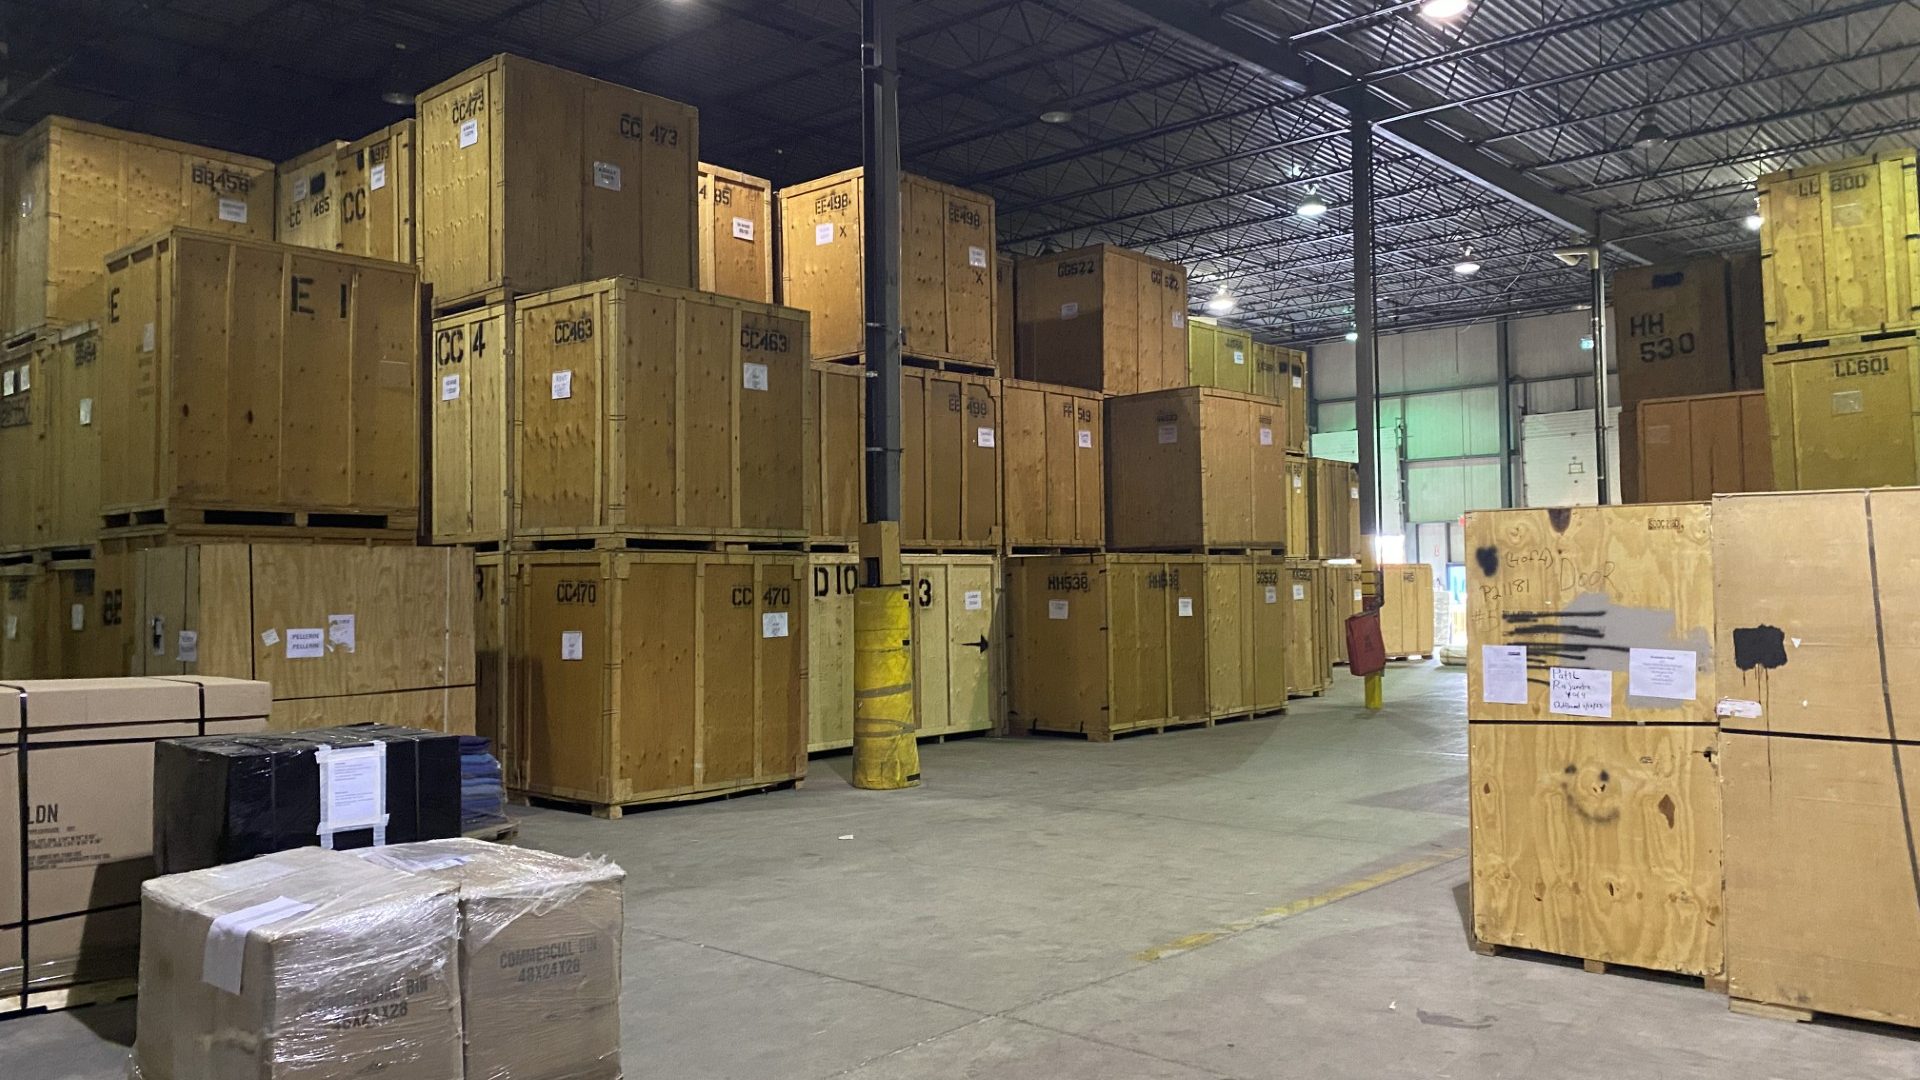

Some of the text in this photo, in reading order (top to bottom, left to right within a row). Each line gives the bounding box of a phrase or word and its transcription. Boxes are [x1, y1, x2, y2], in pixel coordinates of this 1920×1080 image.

[620, 117, 678, 147] CC 473
[1799, 182, 1820, 197] LL
[342, 187, 366, 224] CC
[290, 275, 315, 314] E
[554, 318, 593, 344] CC463
[1630, 313, 1664, 337] HH
[437, 320, 486, 366] CC 4
[741, 328, 788, 353] CC463
[1640, 332, 1695, 363] 530
[1835, 358, 1889, 377] LL601
[556, 582, 597, 604] CC470
[732, 587, 790, 606] CC 470
[918, 578, 932, 608] 3
